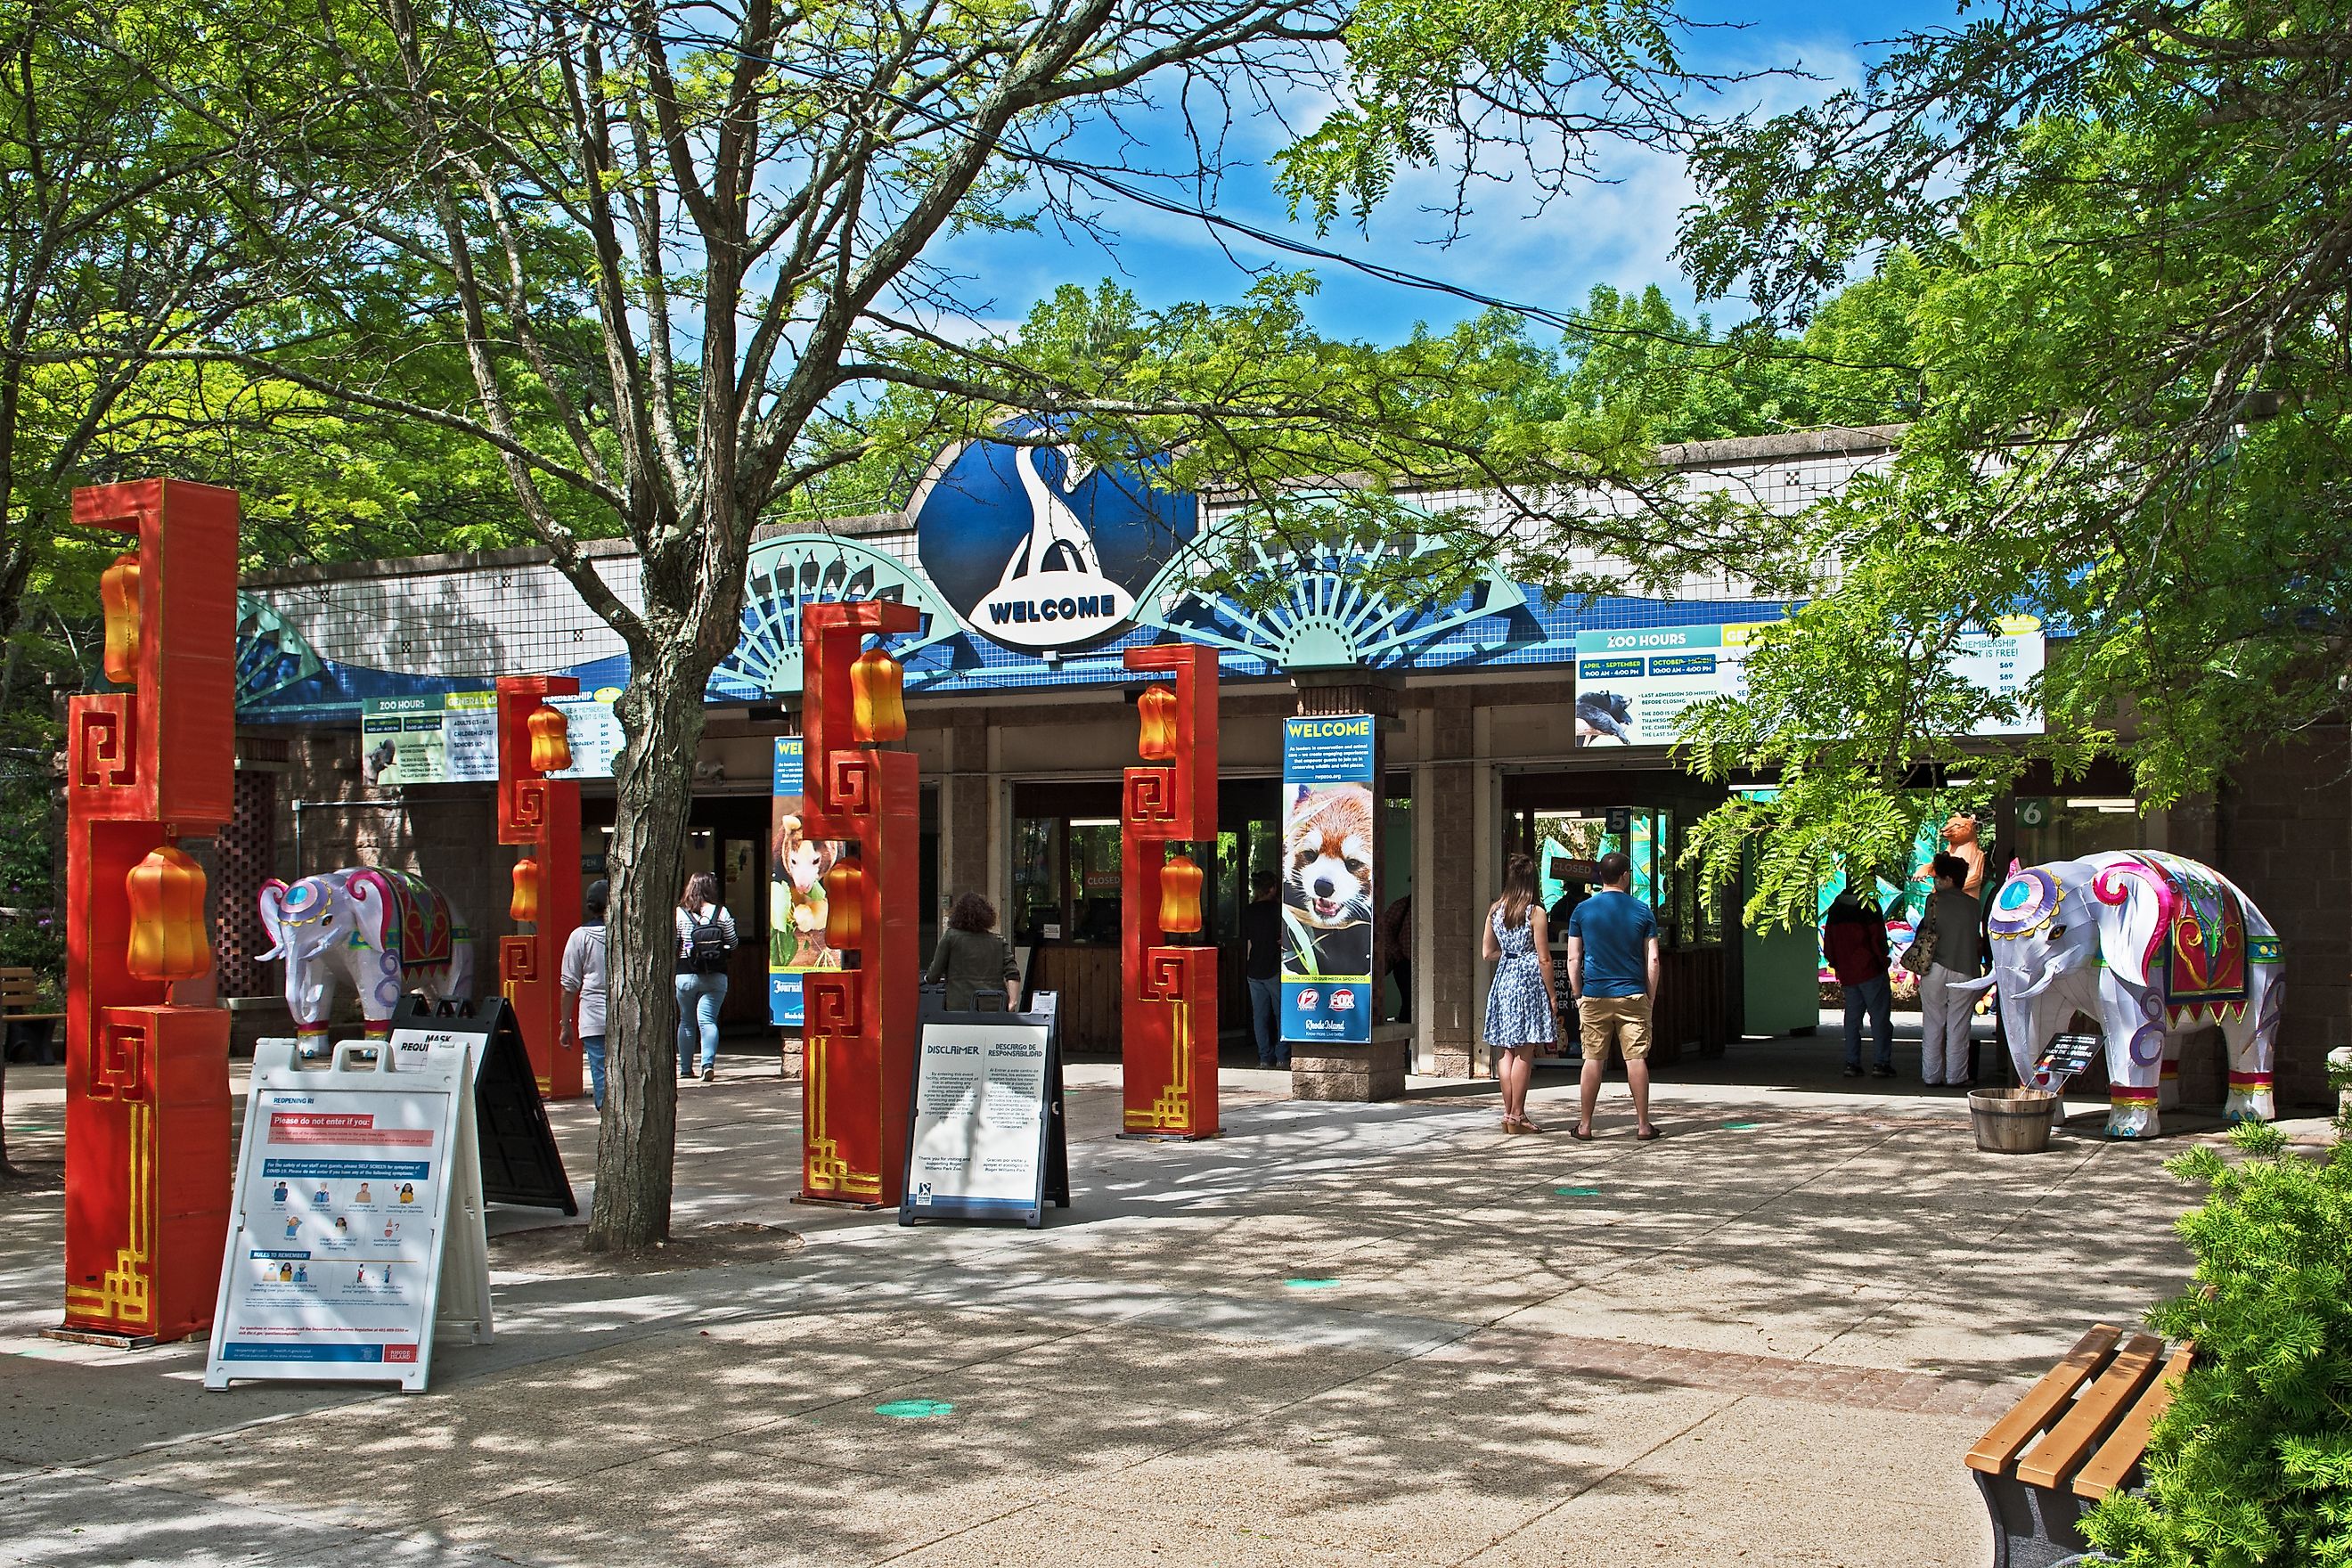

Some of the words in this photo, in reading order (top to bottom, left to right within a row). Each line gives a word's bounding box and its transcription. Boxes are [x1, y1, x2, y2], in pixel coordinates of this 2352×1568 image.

[989, 594, 1115, 624] WELCOME
[1606, 635, 1636, 649] ZOO
[1639, 633, 1686, 647] HOURS
[1996, 649, 2019, 657] FREE!
[1605, 660, 1641, 668] SEPTEMBER
[379, 701, 397, 711] ZOO
[397, 699, 426, 709] HOURS
[448, 697, 485, 706] GENERAL
[1287, 721, 1370, 739] WELCOME
[2023, 802, 2042, 824] 6
[1612, 811, 1626, 830] 5
[1553, 862, 1591, 874] CLOSED
[1087, 876, 1121, 886] CLOSED
[1553, 960, 1567, 968] EET
[1300, 991, 1318, 1007] 12
[1305, 1018, 1325, 1031] Rhode
[425, 1034, 452, 1043] MASK
[401, 1042, 429, 1052] REQUI
[987, 1049, 1043, 1058] RESPONSABILIDAD
[274, 1116, 299, 1124] Please
[300, 1116, 310, 1125] do
[312, 1117, 326, 1125] not
[347, 1117, 354, 1126] if
[354, 1118, 371, 1126] you:
